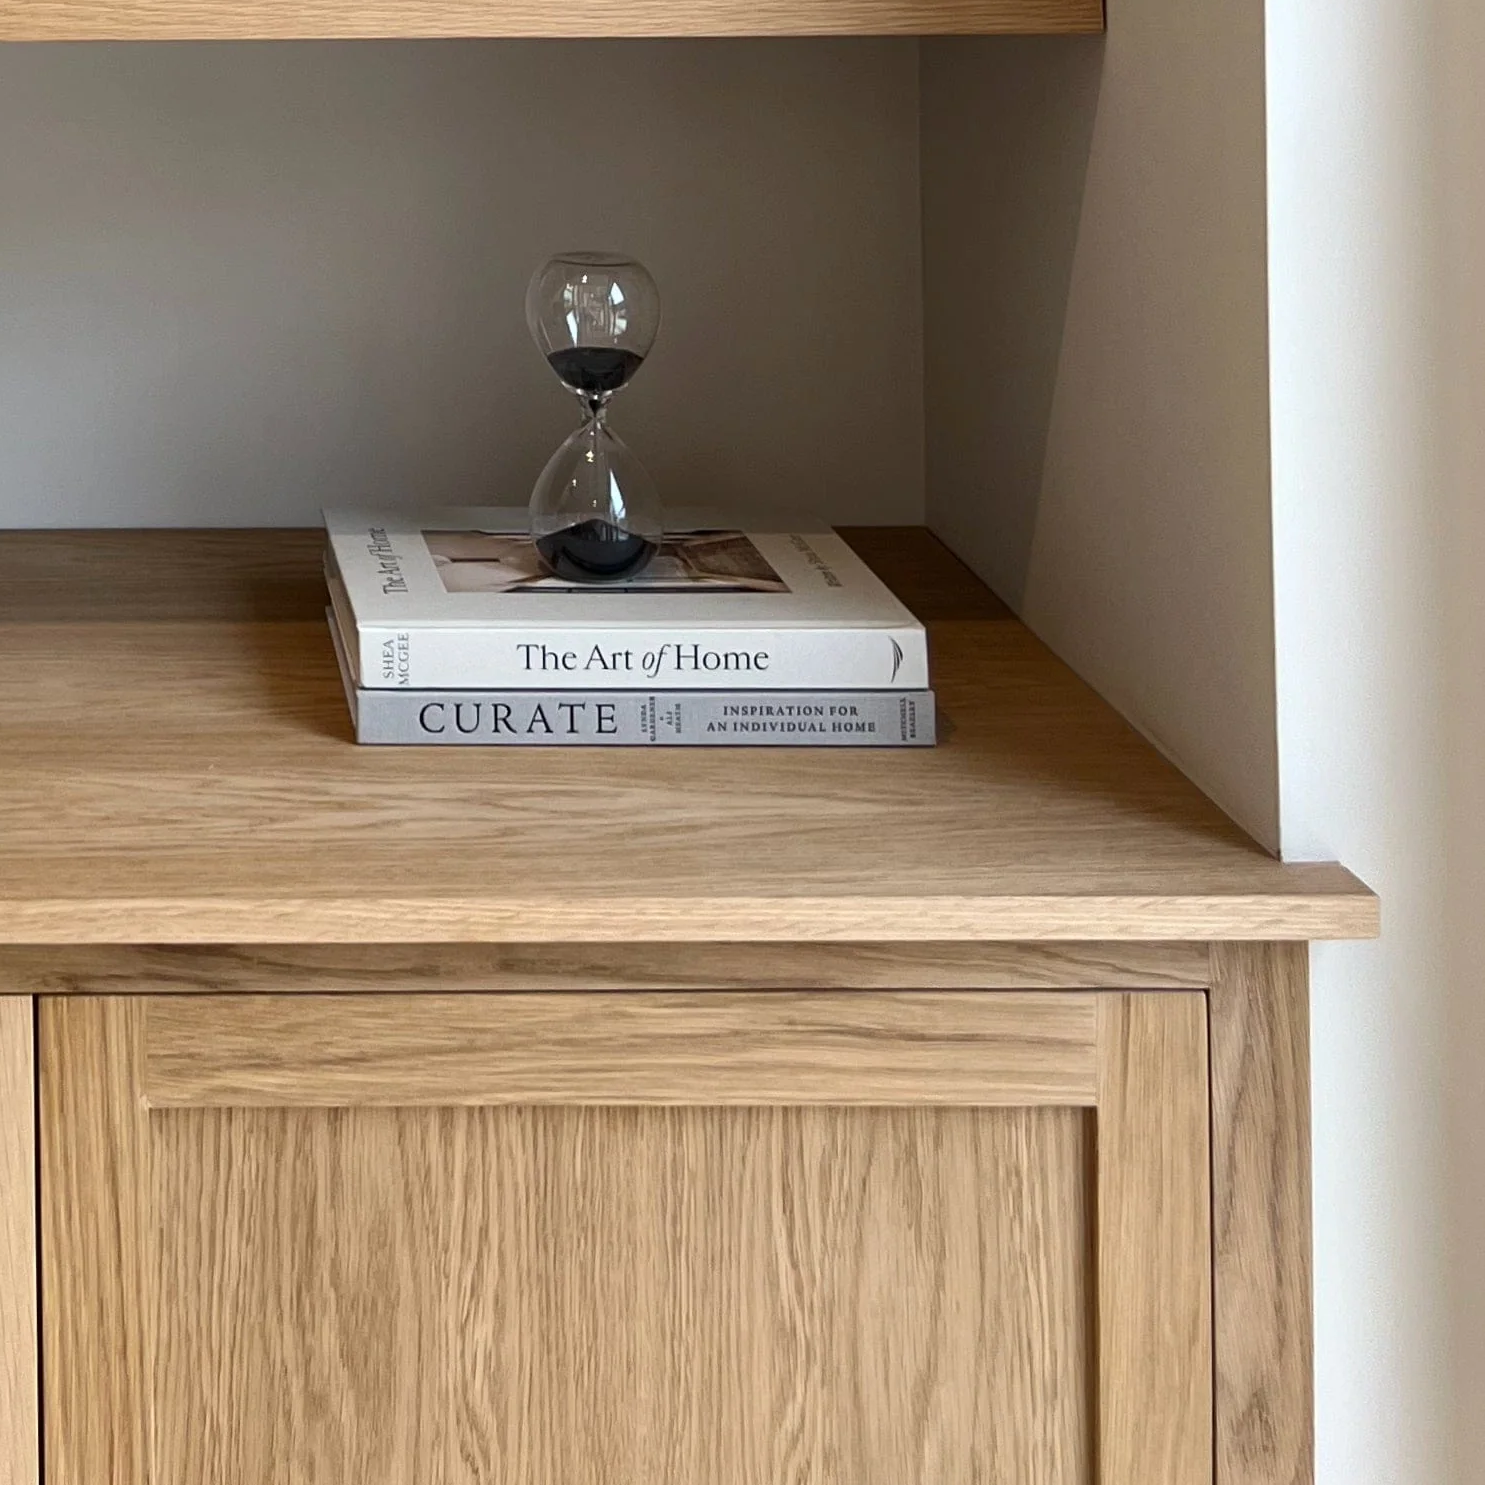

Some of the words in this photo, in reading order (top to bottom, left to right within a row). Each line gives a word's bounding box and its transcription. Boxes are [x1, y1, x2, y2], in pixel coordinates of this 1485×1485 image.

[383, 576, 409, 595] The
[382, 639, 395, 679] SHEA
[397, 632, 410, 686] MCGEE
[516, 643, 577, 671] The
[584, 643, 633, 671] Art
[642, 643, 671, 679] of
[673, 643, 769, 671] Home
[419, 702, 618, 735] CURATE
[723, 705, 825, 716] INSPIRATION
[829, 705, 859, 716] FOR
[706, 722, 727, 733] AN
[733, 722, 826, 733] INDIVIDUAL
[831, 722, 876, 733] HOME
